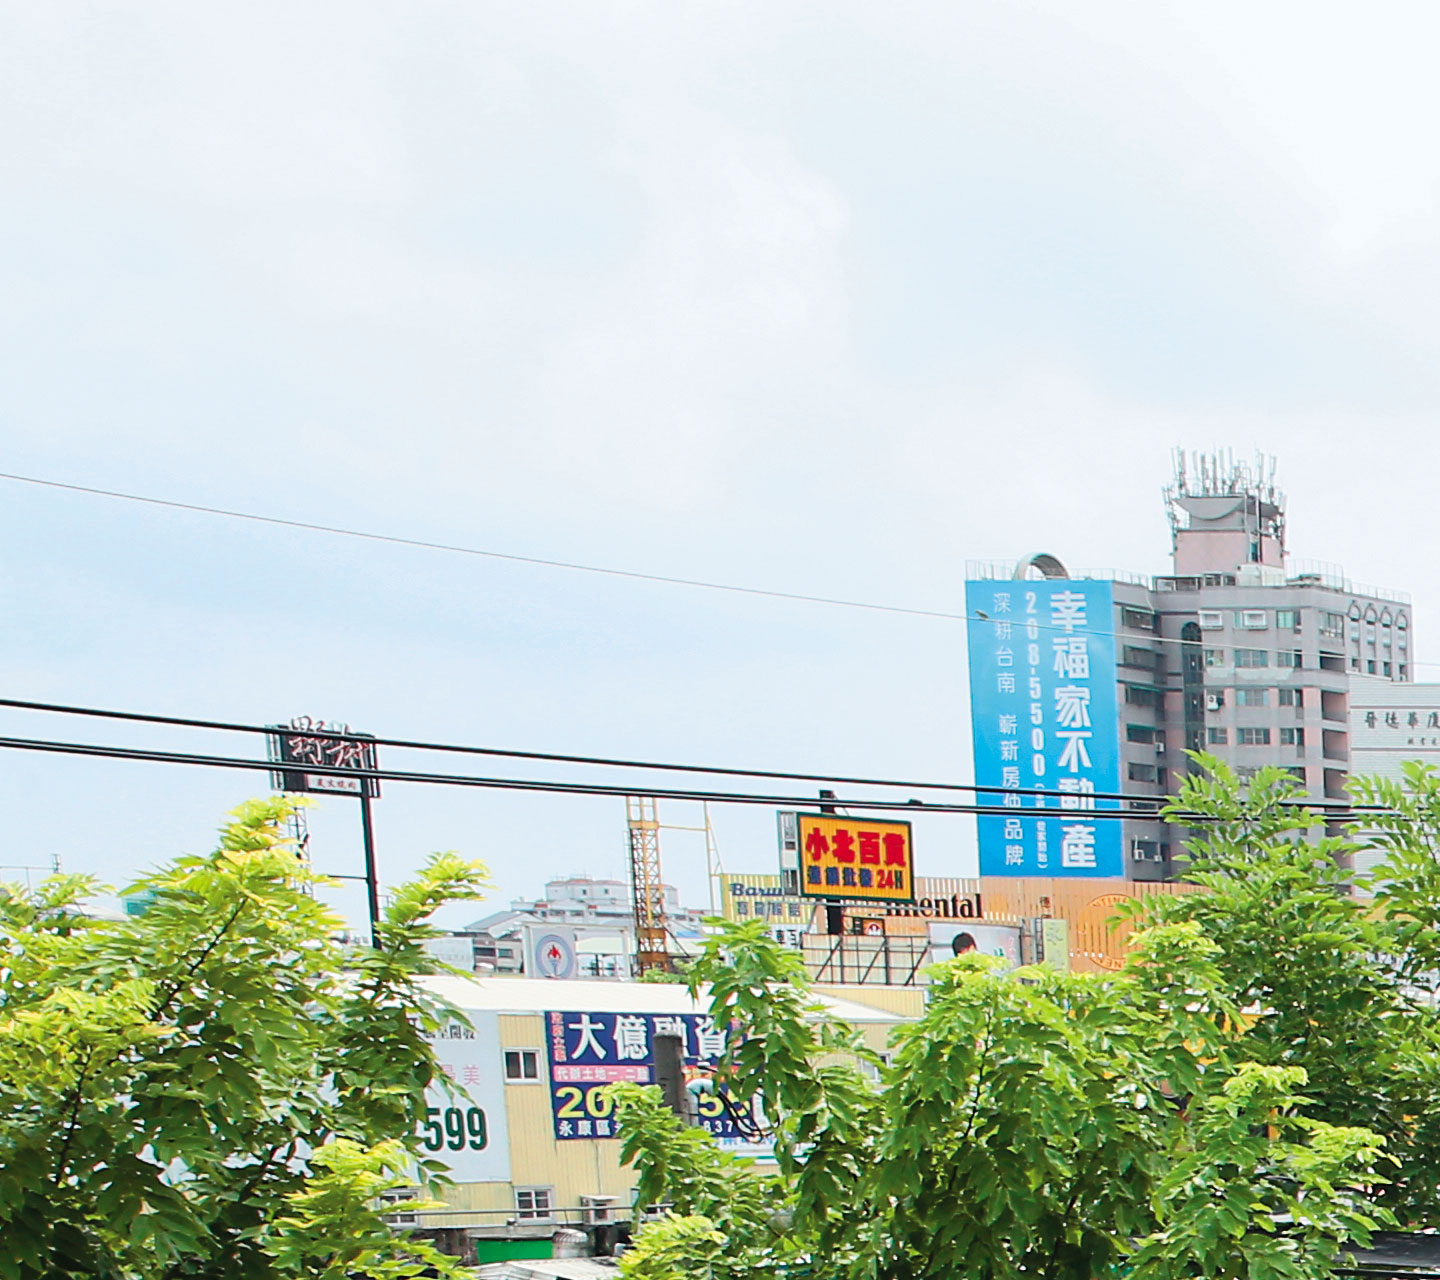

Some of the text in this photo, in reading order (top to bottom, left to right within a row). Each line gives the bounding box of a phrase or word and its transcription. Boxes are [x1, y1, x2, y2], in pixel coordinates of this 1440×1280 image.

[993, 592, 1016, 694] 深耕台南
[1025, 591, 1046, 777] 208-5500
[1050, 590, 1097, 868] 幸福家不動產
[806, 827, 907, 867] 小北百貨
[877, 868, 904, 890] 24H
